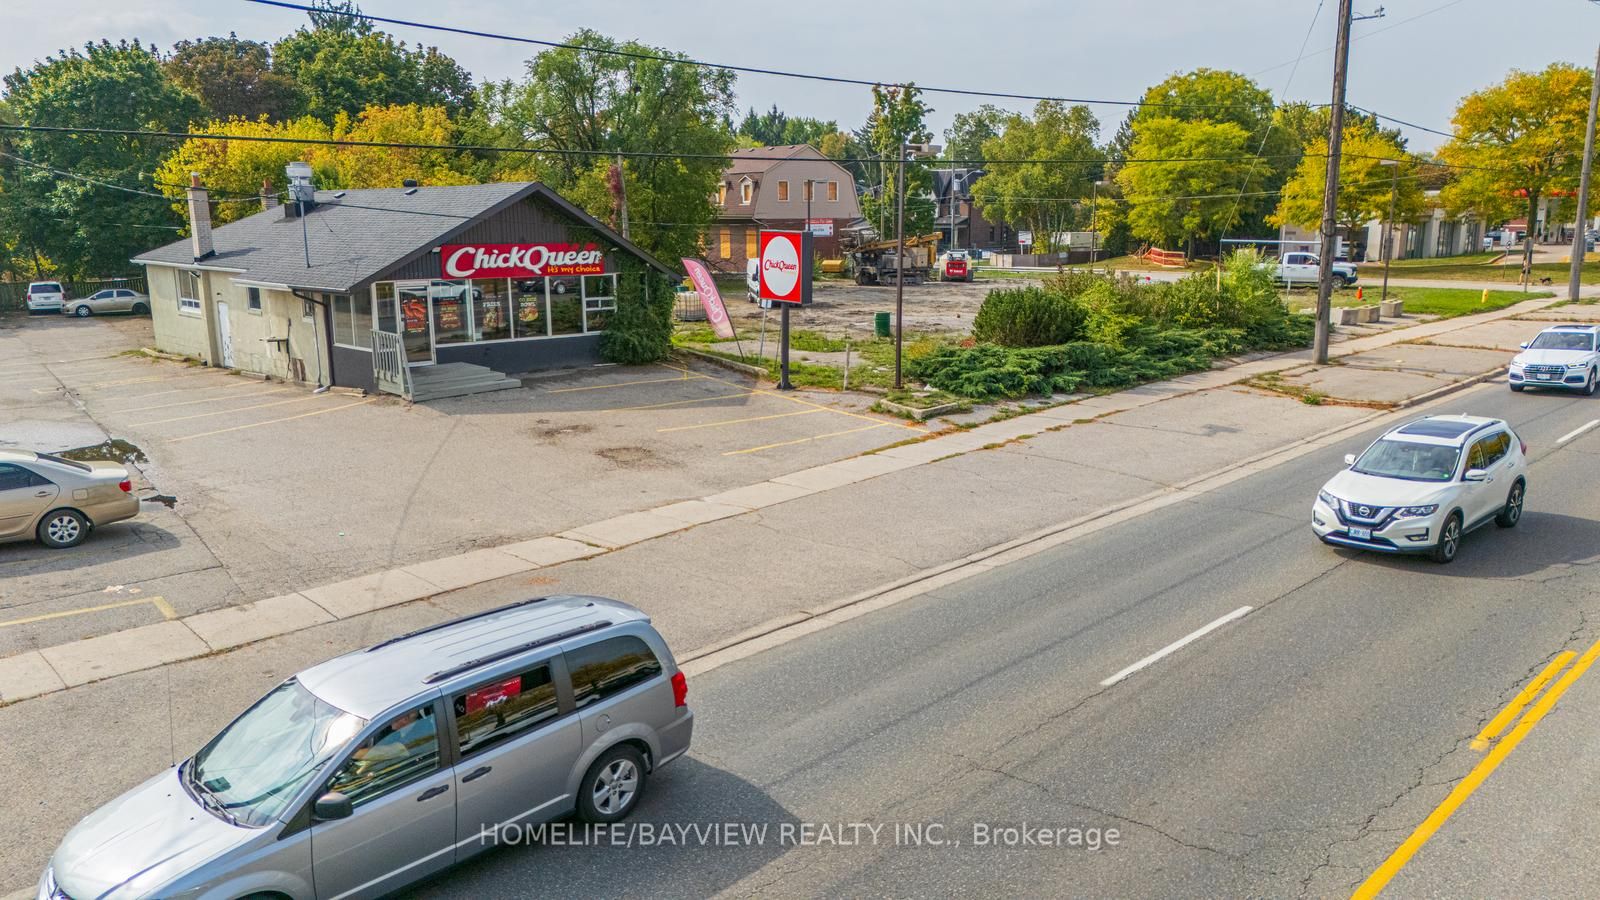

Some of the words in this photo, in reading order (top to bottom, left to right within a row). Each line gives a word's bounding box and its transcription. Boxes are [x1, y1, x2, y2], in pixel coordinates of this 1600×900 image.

[446, 245, 602, 277] ChickQueen
[765, 259, 797, 272] ChickQueen
[561, 266, 574, 274] my
[575, 264, 601, 273] choice
